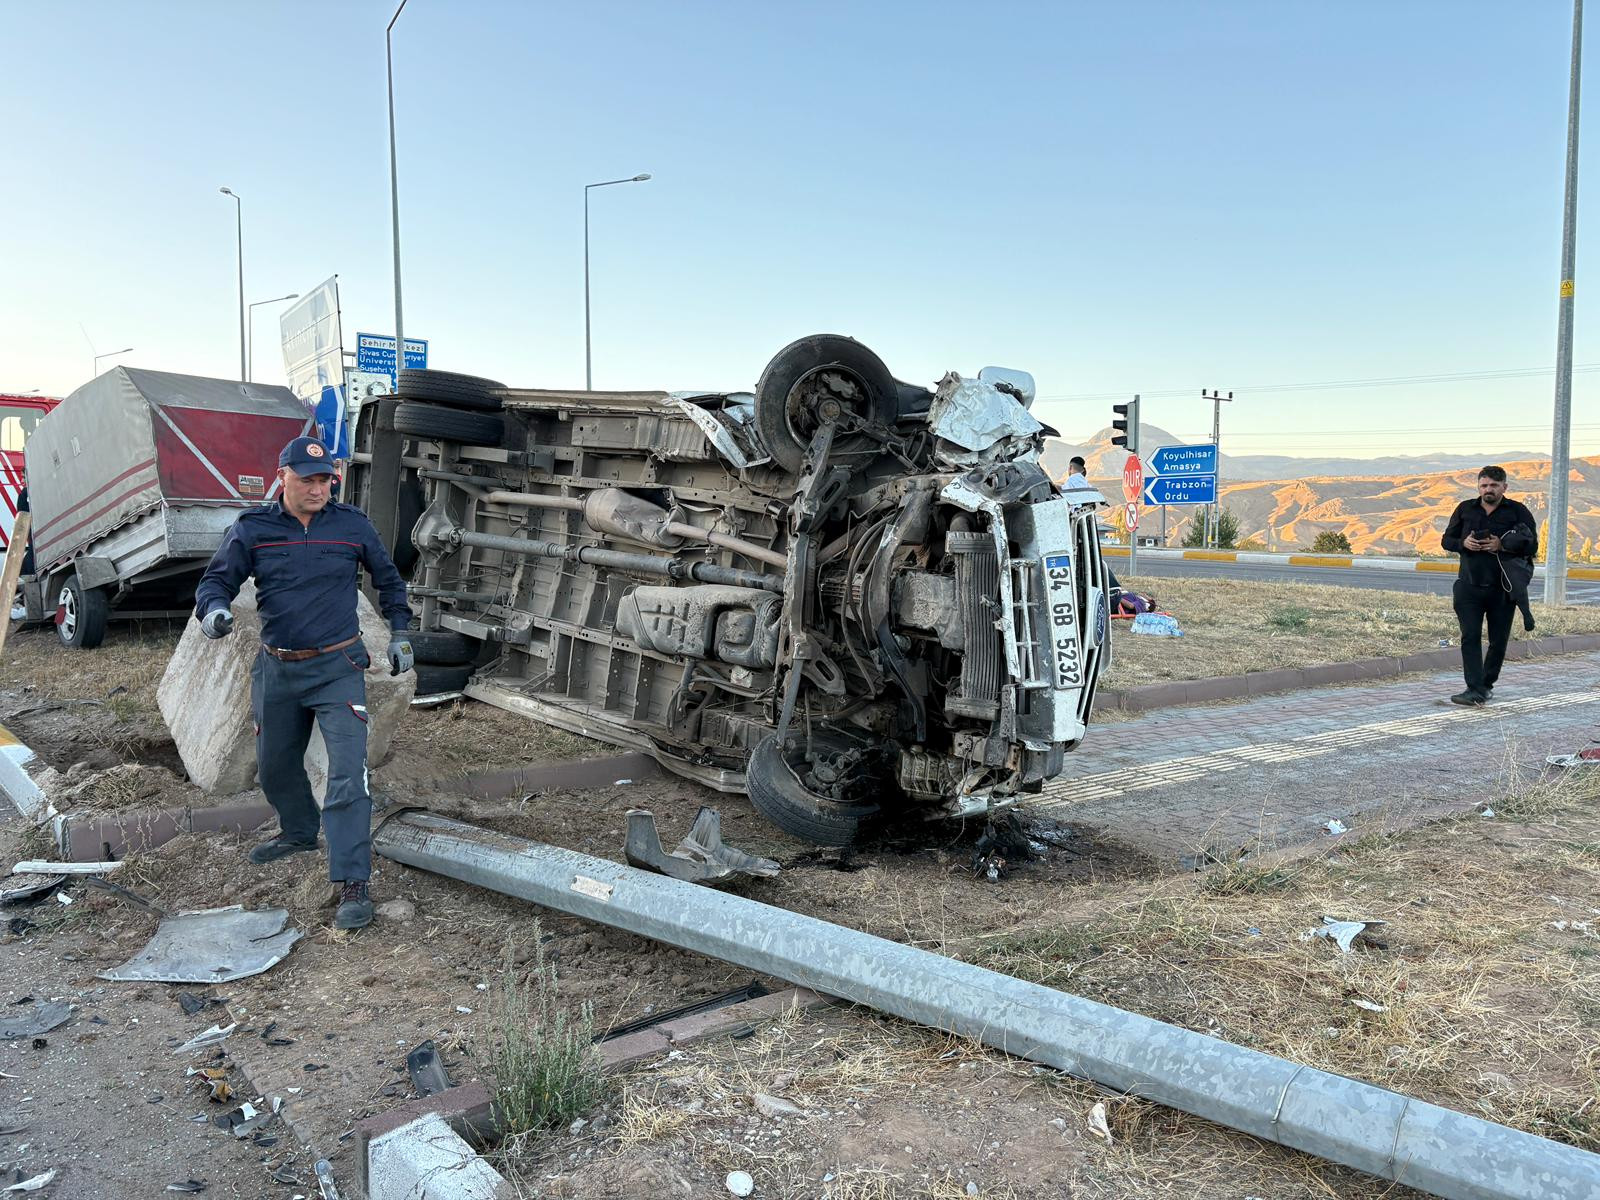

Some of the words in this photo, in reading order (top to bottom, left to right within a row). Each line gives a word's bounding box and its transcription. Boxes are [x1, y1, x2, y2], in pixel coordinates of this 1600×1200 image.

[388, 342, 424, 351] Mkezi
[360, 348, 380, 357] Sivas
[1163, 451, 1212, 461] Koyulhisar
[1163, 462, 1201, 471] Amasya
[1124, 470, 1140, 487] DUR
[1165, 480, 1207, 489] Trabzon
[1165, 492, 1189, 500] Ordu
[1049, 559, 1056, 567] TR
[1049, 568, 1070, 591] 34
[1053, 603, 1074, 626] GB
[1096, 603, 1105, 634] Ford
[1056, 638, 1080, 685] 5232
